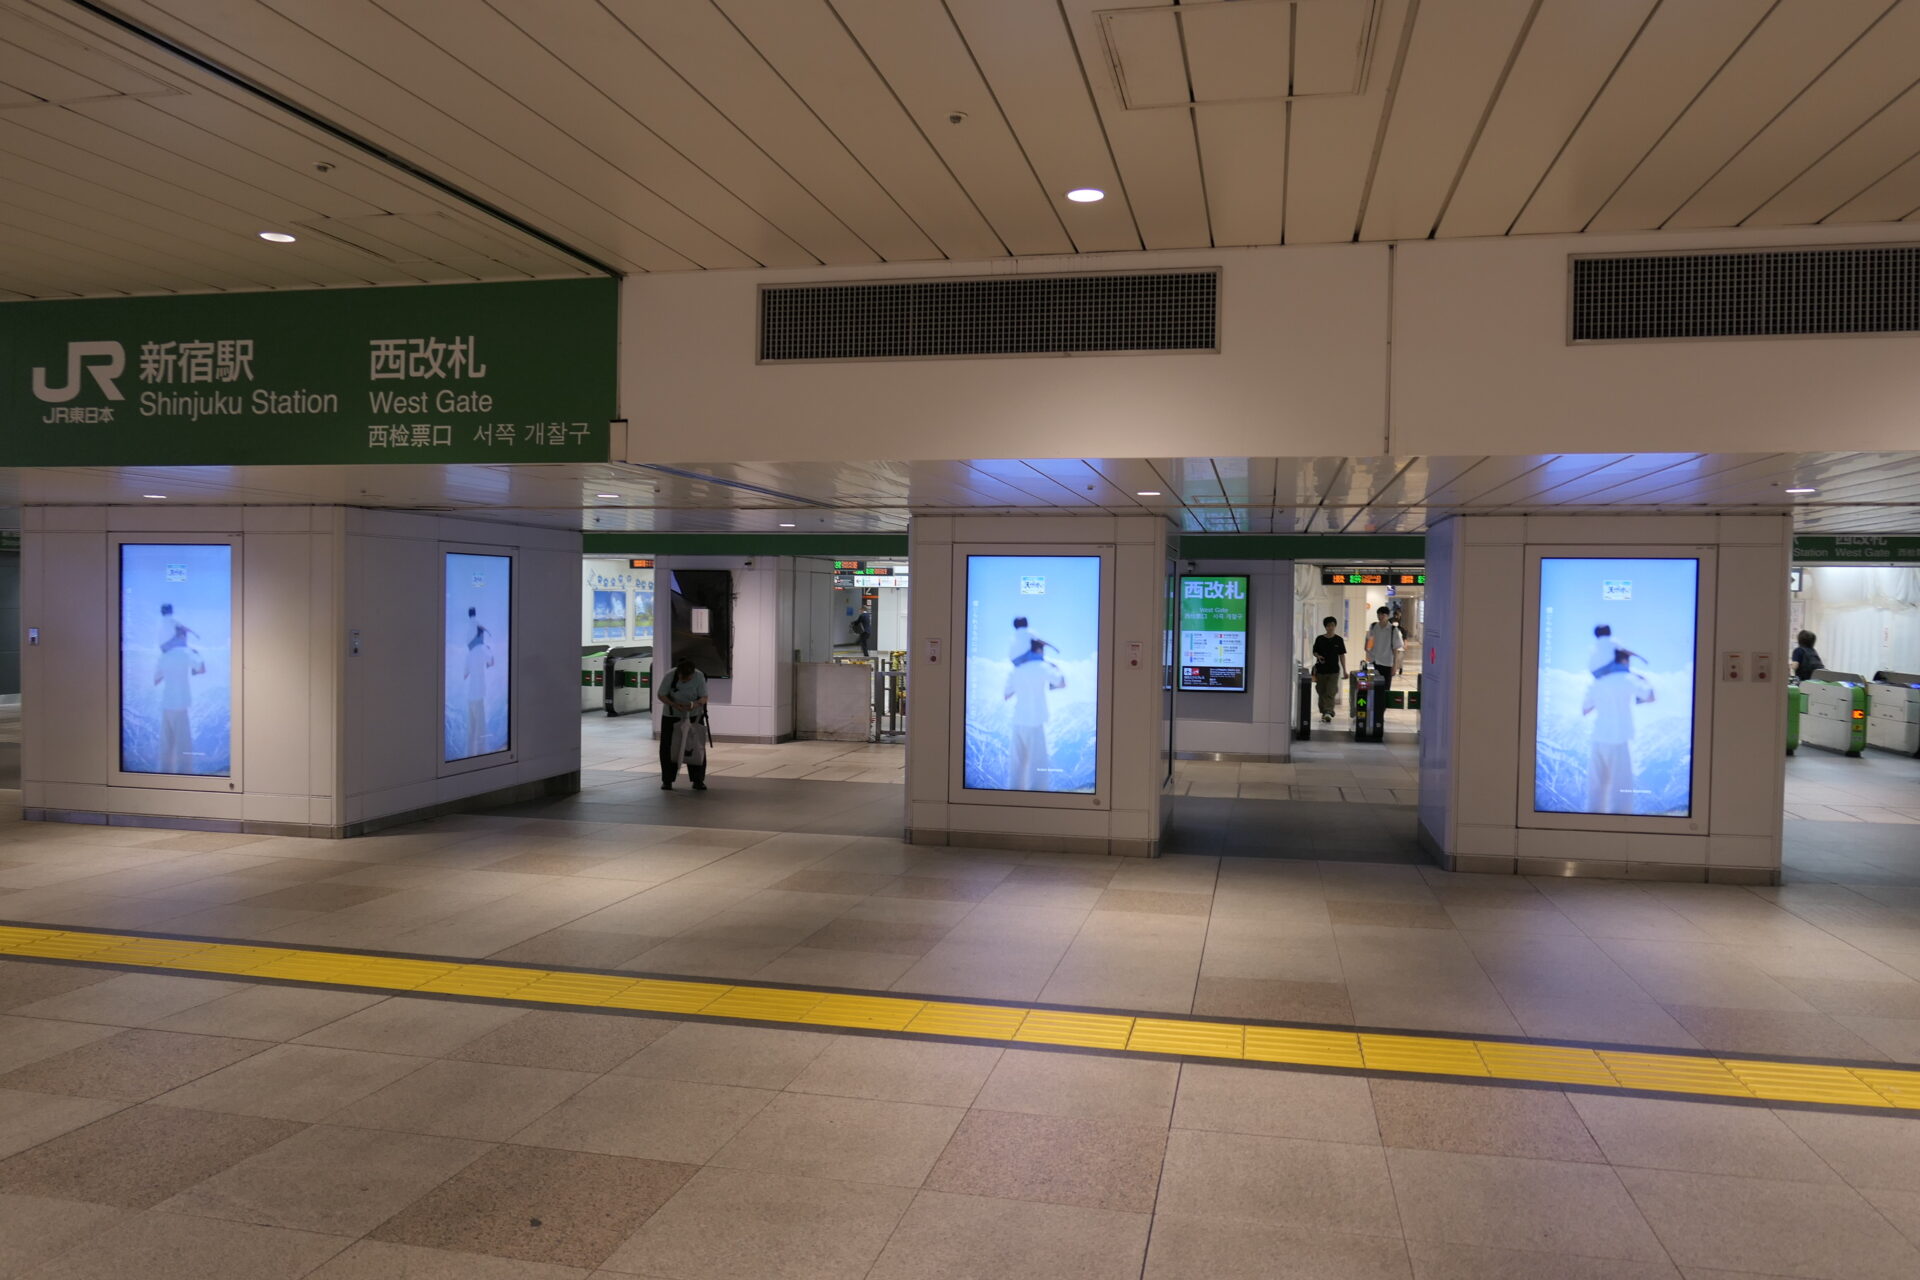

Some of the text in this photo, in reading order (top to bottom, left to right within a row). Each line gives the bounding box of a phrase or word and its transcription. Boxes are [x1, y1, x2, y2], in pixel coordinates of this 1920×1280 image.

[139, 339, 255, 384] 新宿駅
[369, 335, 487, 381] 西改札
[32, 340, 126, 403] JR
[139, 388, 338, 422] Shinjuku Station
[368, 389, 493, 414] West Gate
[43, 406, 115, 424] JR東日本
[368, 423, 452, 448] 西检票口
[473, 421, 591, 446] 서쪽 개찰구
[1835, 547, 1862, 557] West
[1864, 547, 1890, 557] Gate
[1184, 581, 1244, 600] 西改札
